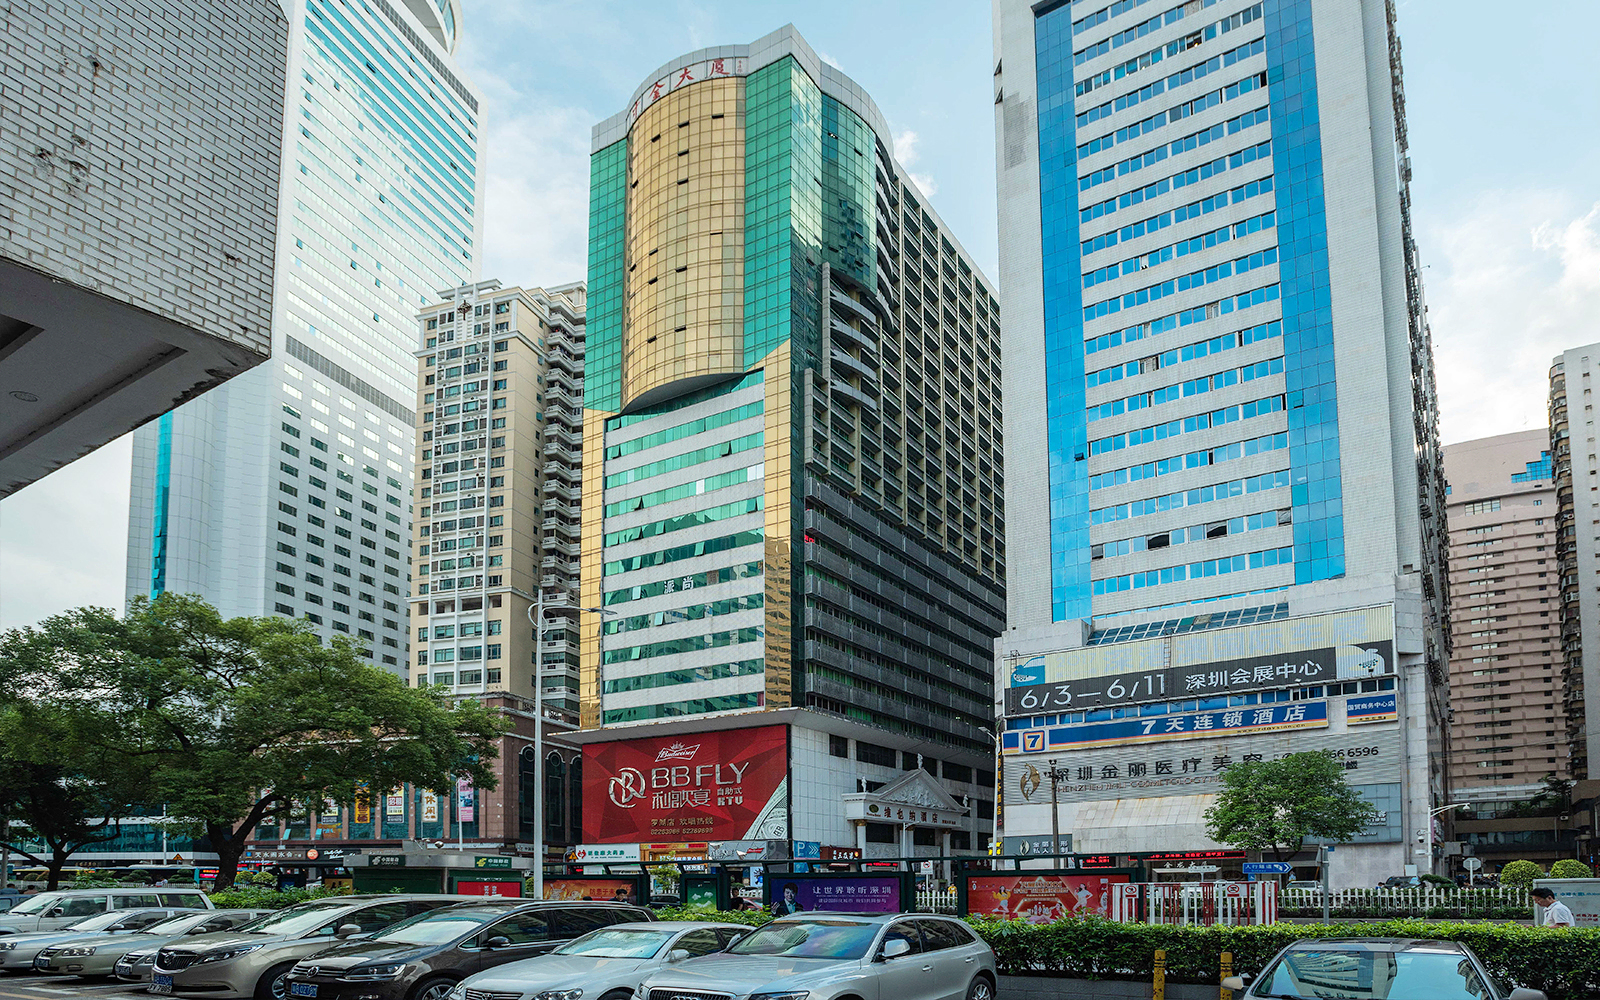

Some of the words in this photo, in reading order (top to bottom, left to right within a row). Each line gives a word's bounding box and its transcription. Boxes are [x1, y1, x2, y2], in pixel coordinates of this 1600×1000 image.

[1185, 659, 1323, 691] 深圳会展中心
[1347, 699, 1395, 711] 国贸商务中心店
[1026, 734, 1041, 748] 7
[1347, 746, 1379, 758] 6596
[884, 806, 938, 823] 维也纳酒店
[812, 886, 892, 895] 让世界聆听深圳
